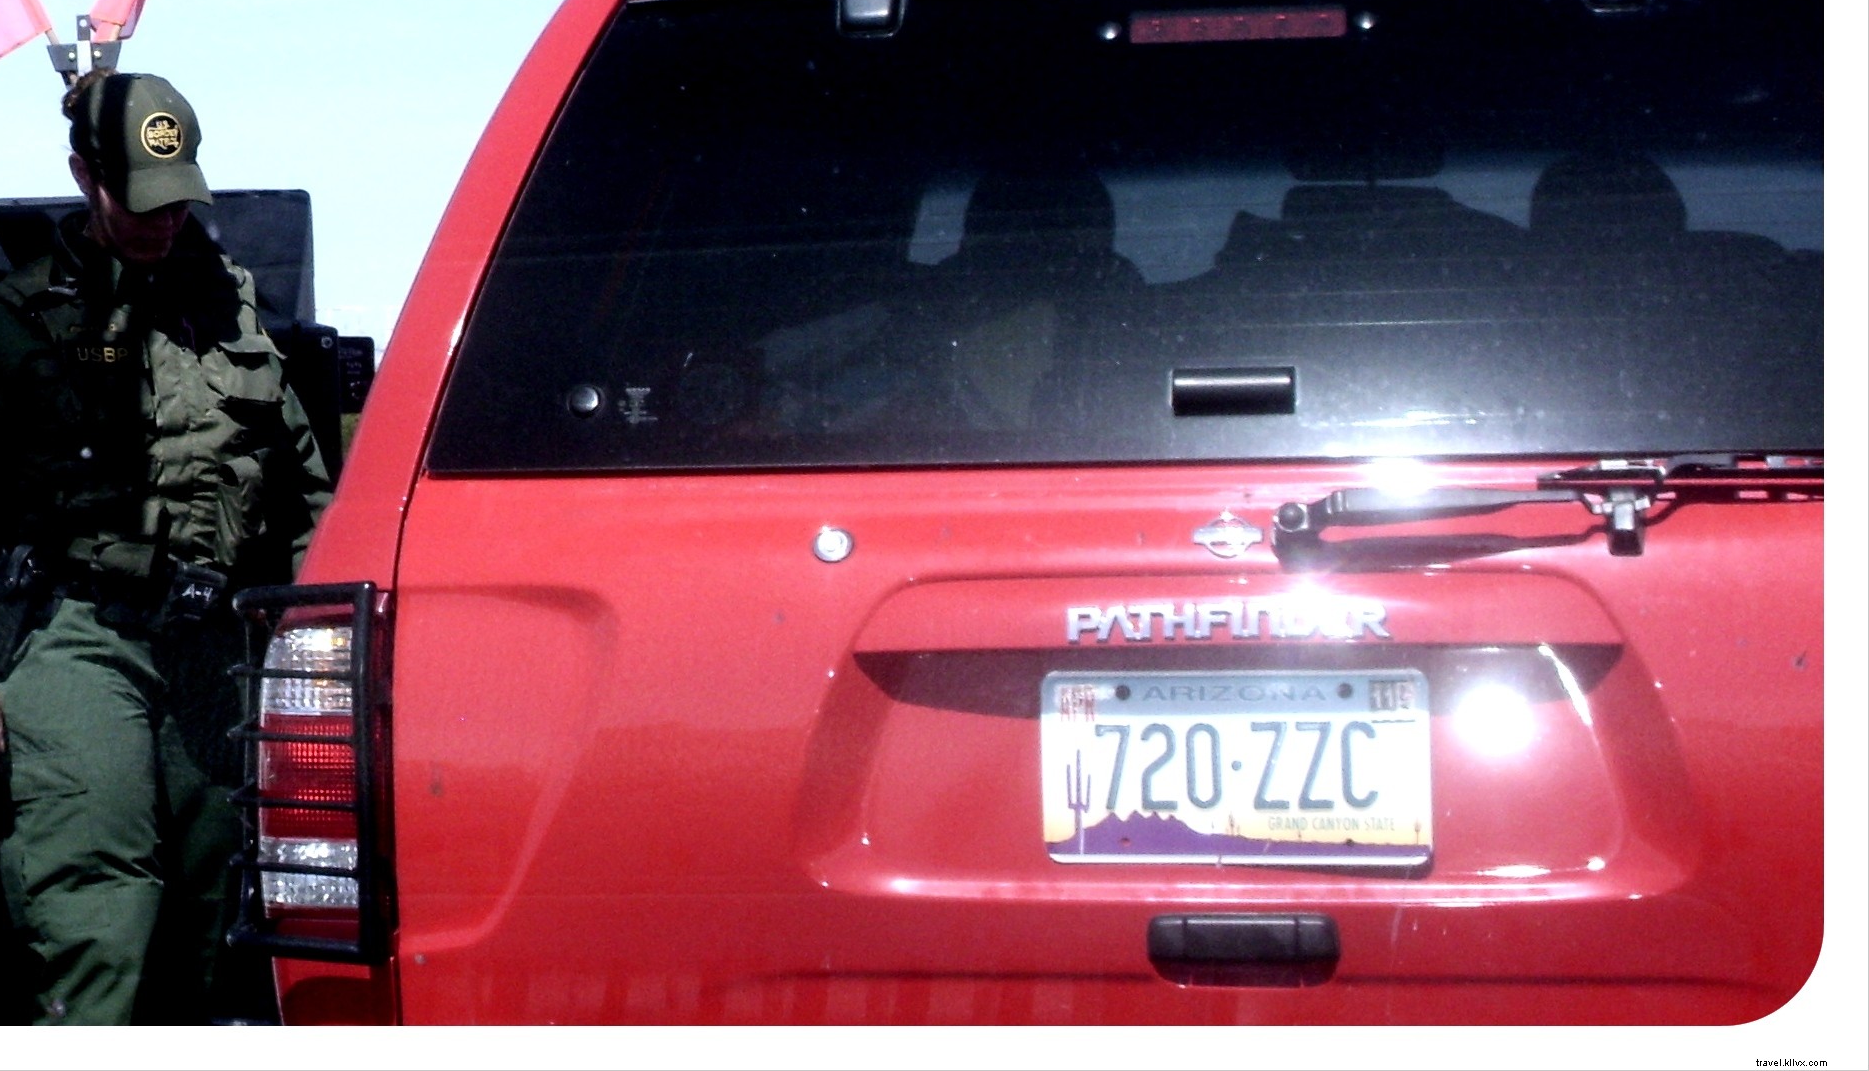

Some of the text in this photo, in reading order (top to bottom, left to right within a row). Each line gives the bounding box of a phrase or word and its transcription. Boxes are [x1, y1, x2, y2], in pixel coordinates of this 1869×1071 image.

[77, 346, 129, 363] USBP
[1142, 685, 1326, 702] ARIZONA
[1268, 816, 1396, 831] GRAND CANYON STATE
